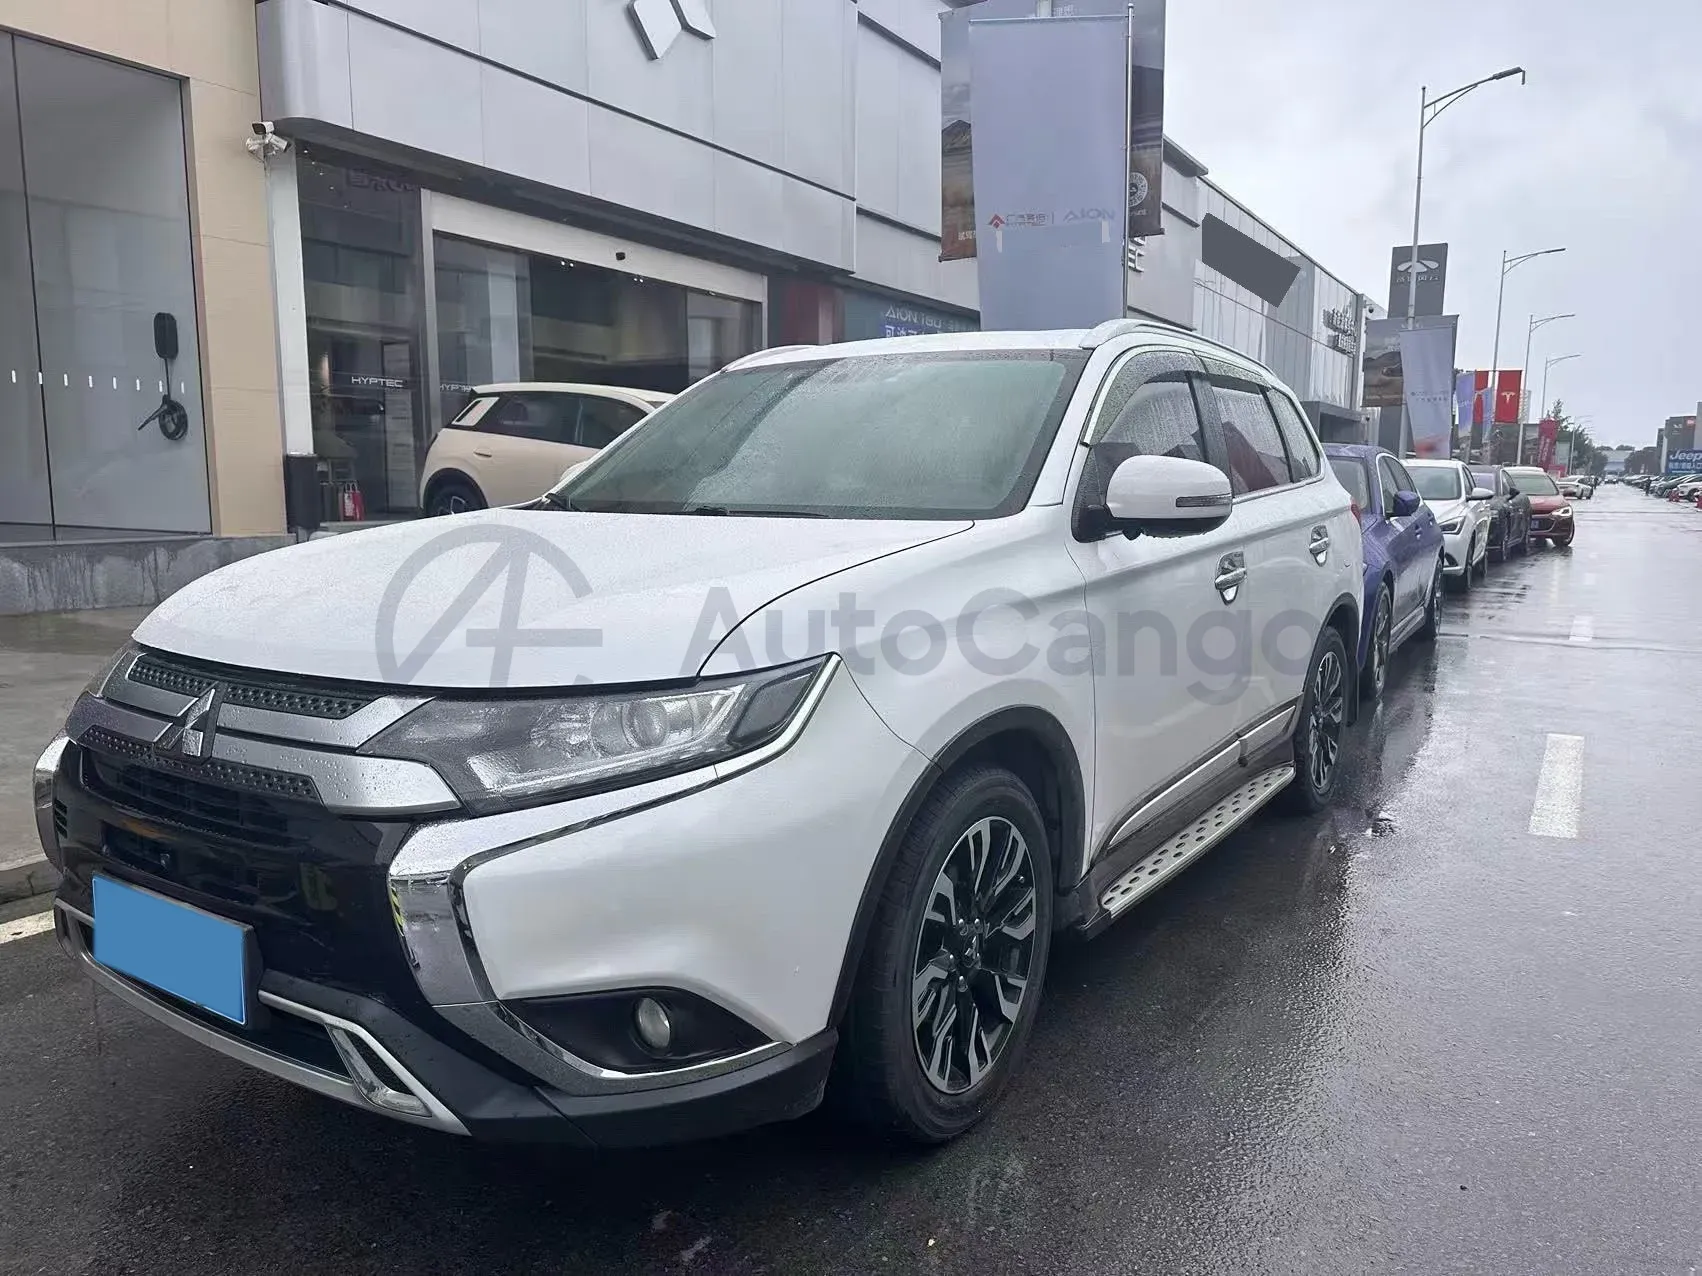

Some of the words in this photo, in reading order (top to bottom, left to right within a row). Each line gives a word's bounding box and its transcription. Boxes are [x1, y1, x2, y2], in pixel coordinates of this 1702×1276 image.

[1063, 208, 1116, 223] AION
[885, 305, 918, 324] AION
[351, 376, 404, 388] HYPTEC
[1669, 449, 1702, 462] Jeep
